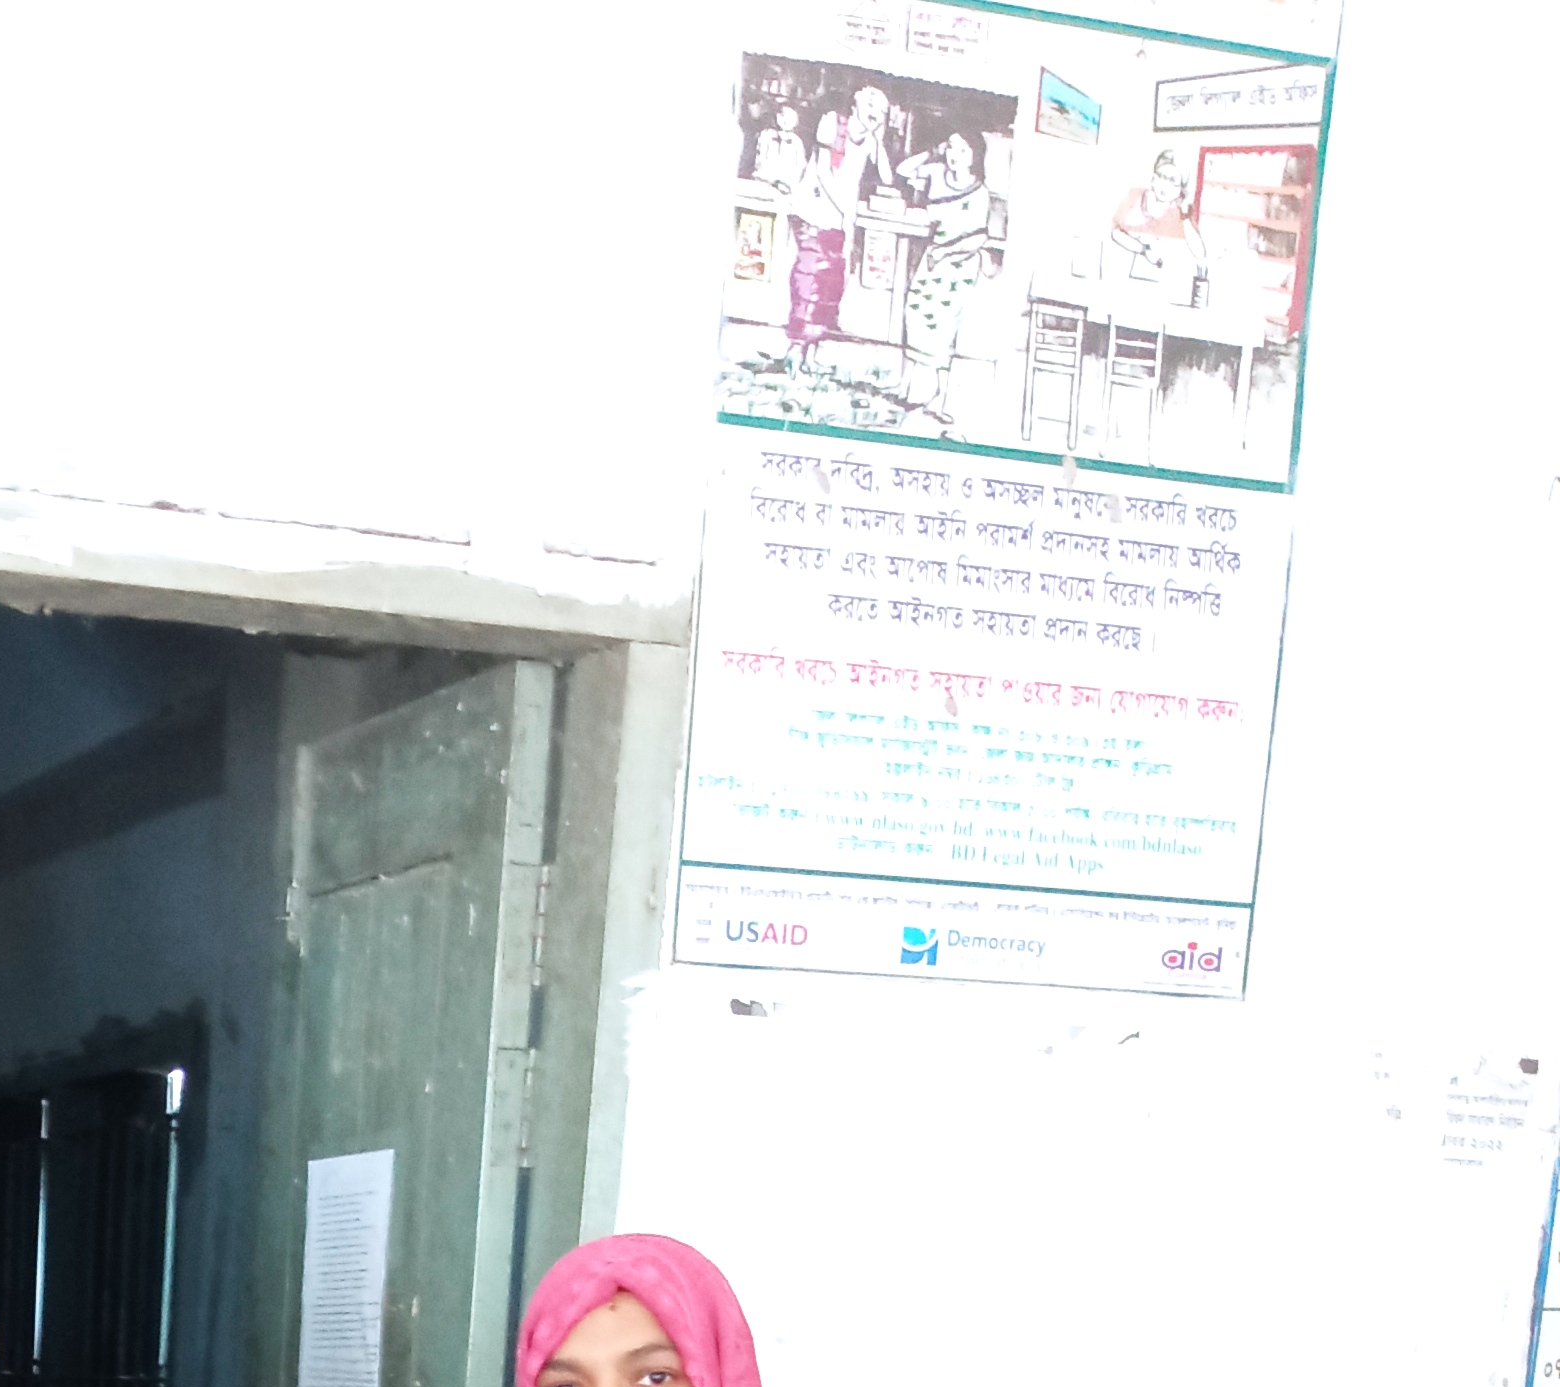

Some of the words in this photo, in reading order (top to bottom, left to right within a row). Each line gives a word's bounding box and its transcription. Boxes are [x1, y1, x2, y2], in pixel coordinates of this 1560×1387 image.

[751, 486, 806, 523] বিরোধ
[815, 503, 832, 526] বা
[841, 506, 905, 536] মামলার
[914, 509, 966, 540] আইনি
[961, 477, 973, 499] ও
[1124, 493, 1187, 526] সরকারি
[1195, 505, 1238, 532] খরচে
[841, 552, 876, 579] এবং
[1039, 573, 1095, 601] মাধ্যমে
[1103, 571, 1155, 608] বিরোধ
[827, 594, 878, 620] করতে
[888, 597, 964, 629] আইনগত
[1044, 617, 1088, 643] প্রদান
[726, 919, 808, 946] USAID
[947, 929, 1046, 958] Democracy
[1162, 941, 1223, 973] aid
